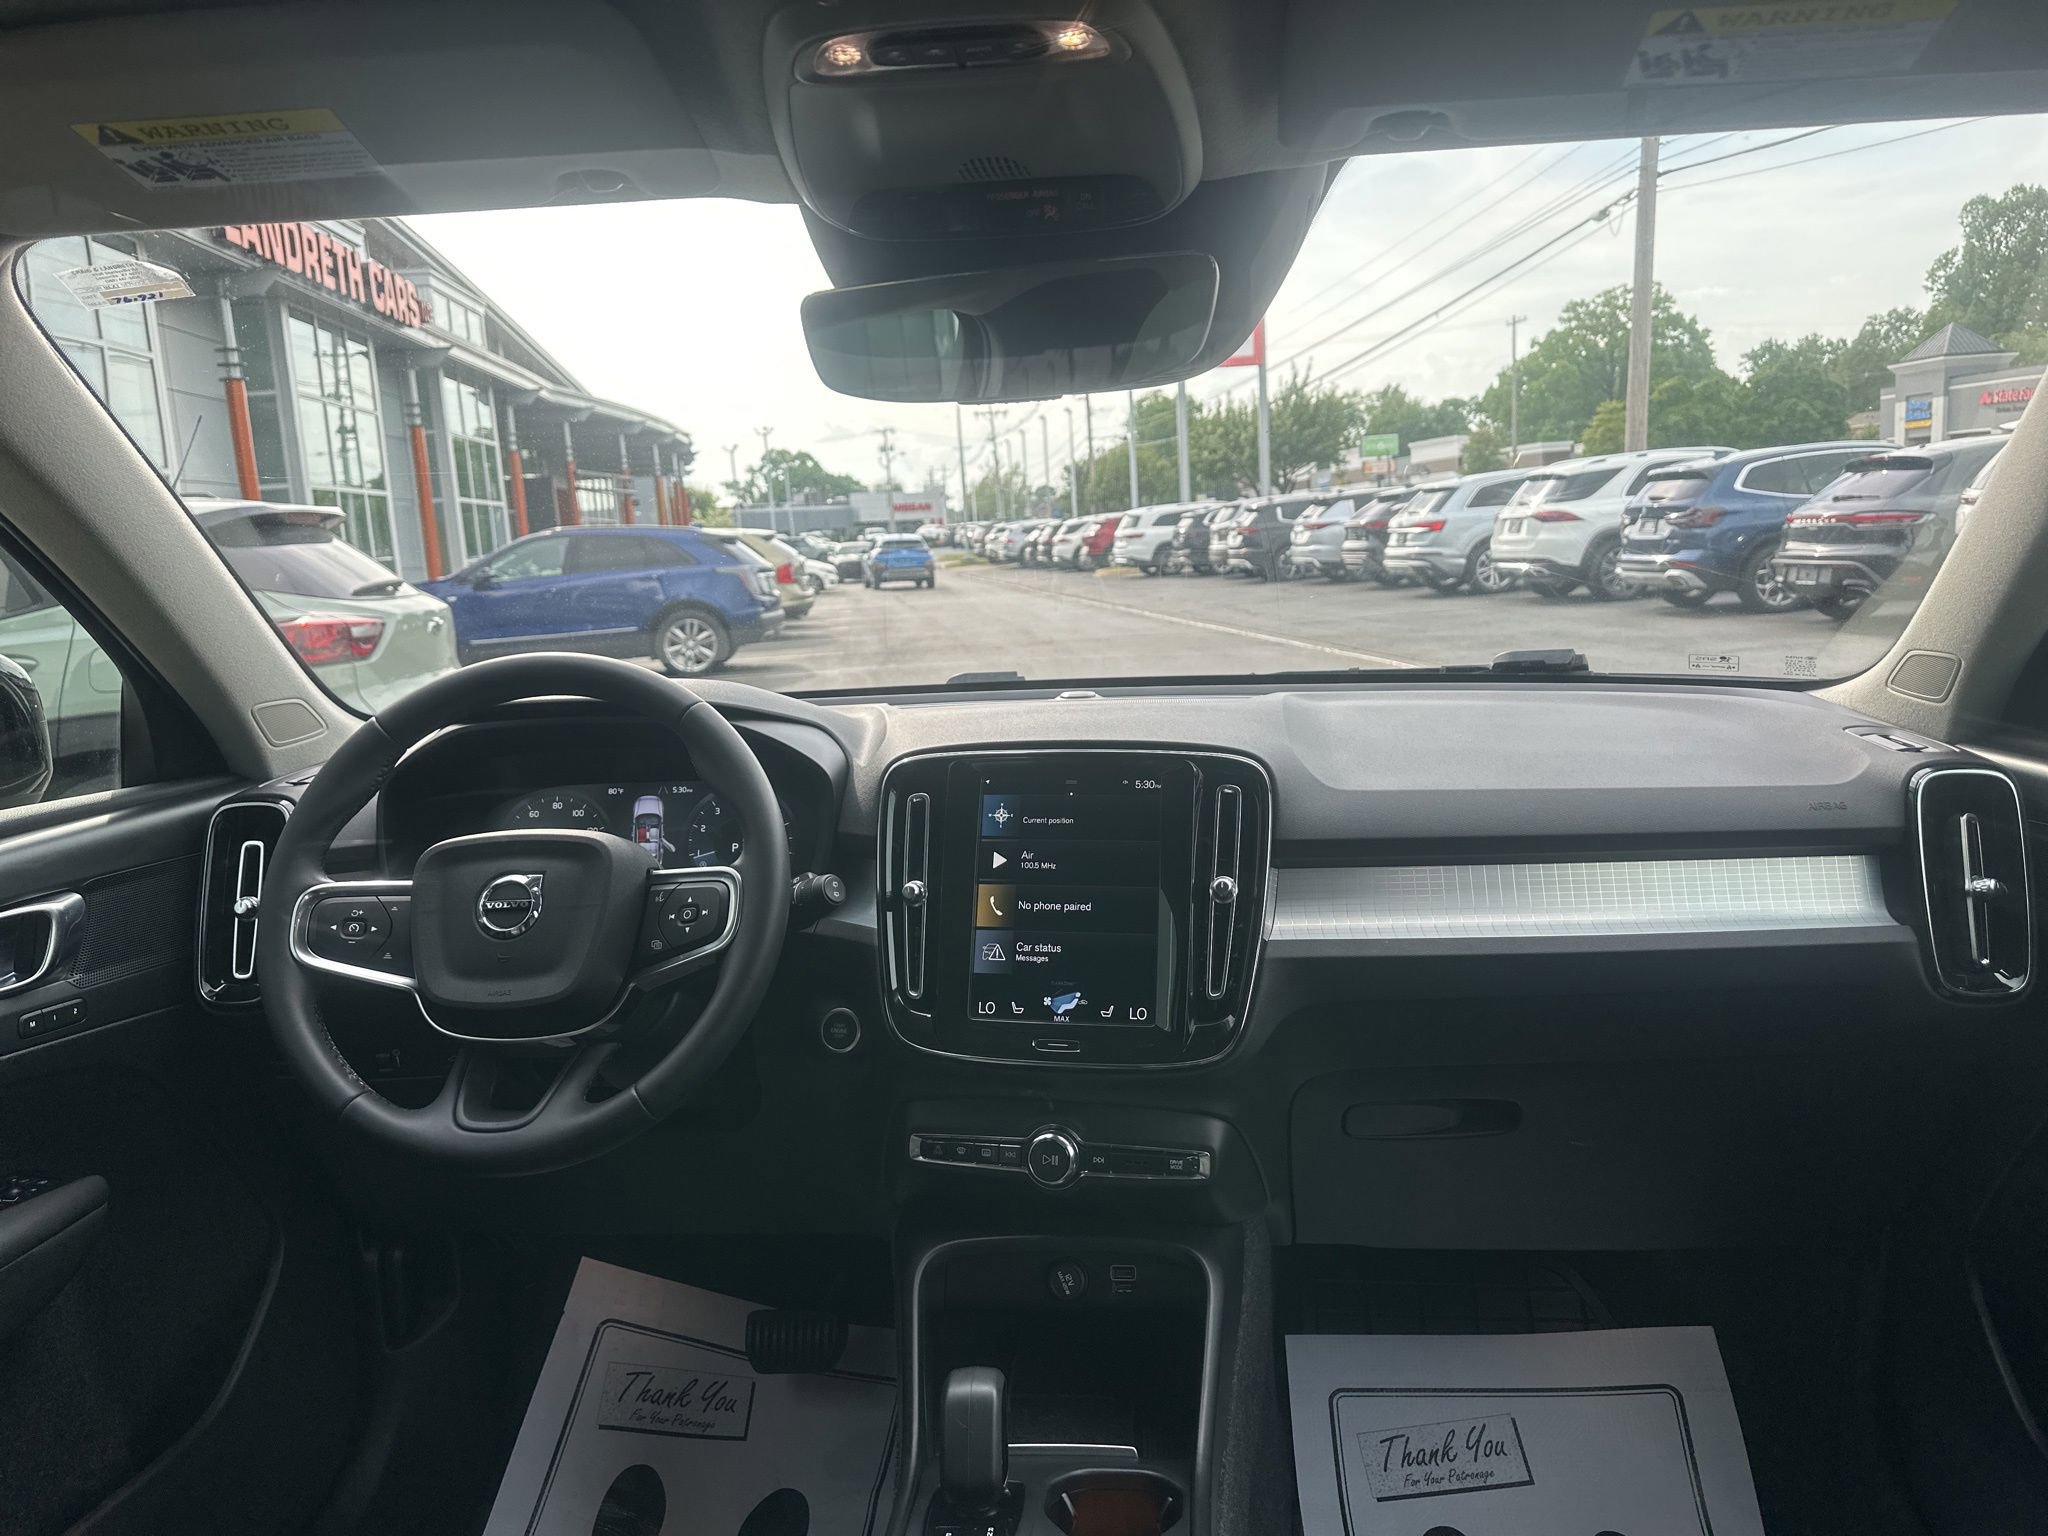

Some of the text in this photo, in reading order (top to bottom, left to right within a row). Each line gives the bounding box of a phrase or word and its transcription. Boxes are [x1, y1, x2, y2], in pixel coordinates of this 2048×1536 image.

[137, 117, 290, 141] WARNING
[368, 260, 422, 328] CARS
[552, 802, 563, 810] 80
[528, 810, 540, 818] 60
[572, 809, 585, 817] 100
[1022, 816, 1074, 826] Current position
[731, 843, 739, 853] P
[1021, 850, 1034, 860] Air
[485, 901, 529, 909] VOLVO
[1018, 900, 1092, 913] No phone paired
[1016, 941, 1062, 953] Car status
[1015, 953, 1049, 964] Messages
[978, 1001, 996, 1014] LO
[1053, 1015, 1070, 1023] MAX
[1129, 1007, 1148, 1021] LO
[618, 1371, 739, 1414] Thank You
[629, 1408, 647, 1421] For
[1379, 1423, 1508, 1473] Thank You
[1404, 1468, 1496, 1488] For Your Patronage
